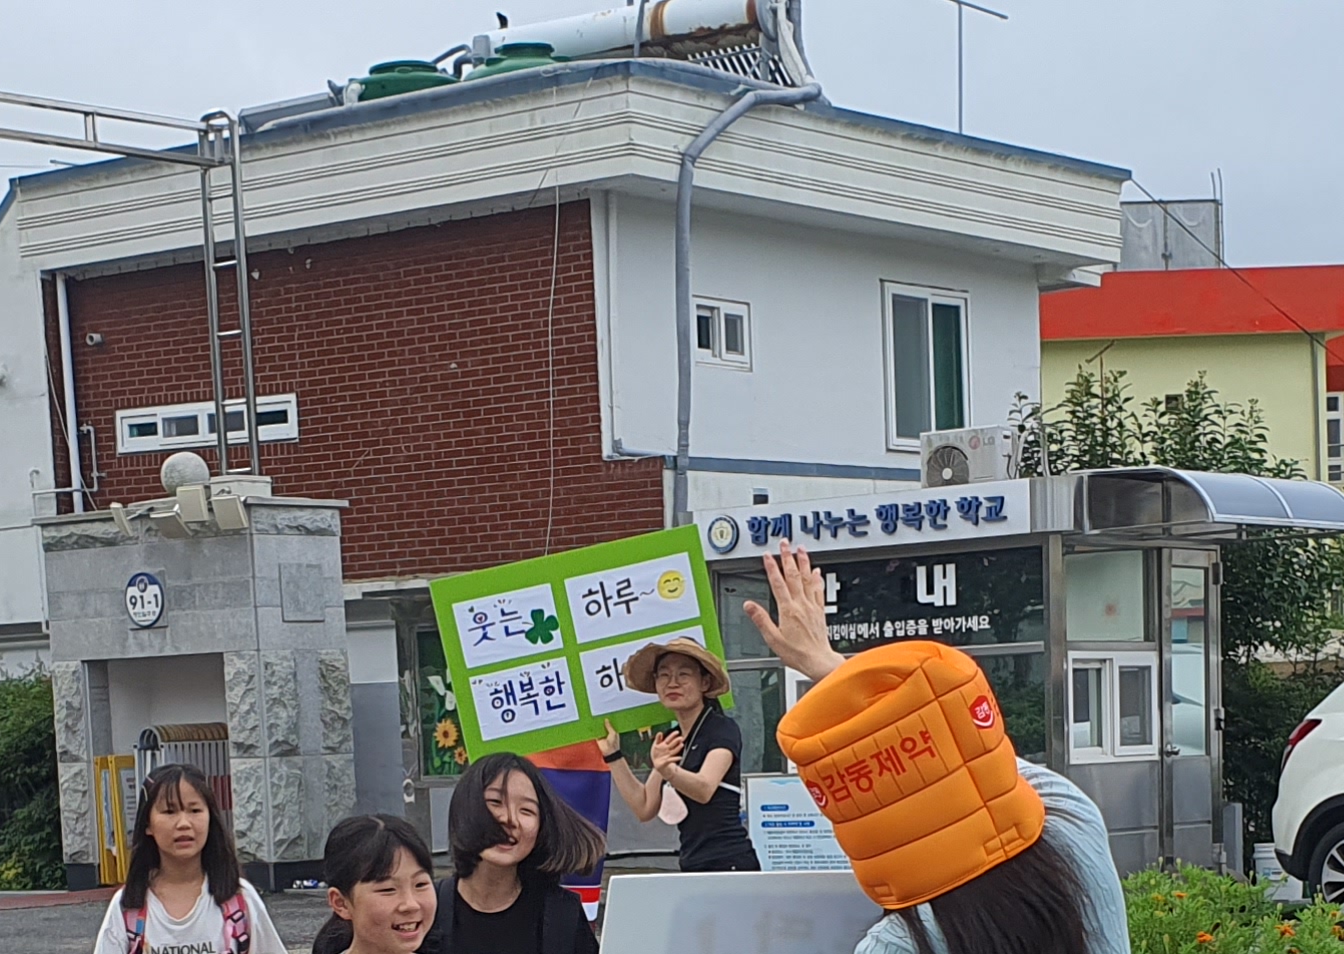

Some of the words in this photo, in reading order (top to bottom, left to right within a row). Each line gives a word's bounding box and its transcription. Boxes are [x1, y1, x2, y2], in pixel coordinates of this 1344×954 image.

[747, 513, 792, 545] 함께
[800, 509, 870, 540] 나누는
[875, 499, 951, 535] 행복한
[955, 496, 1007, 527] 학교
[129, 593, 159, 610] 91-1
[916, 563, 957, 607] 내
[468, 607, 527, 647] 웃는
[882, 619, 929, 638] 출입증을
[931, 614, 992, 634] 받아가세요
[489, 670, 567, 724] 행복한
[595, 657, 626, 692] 하
[821, 729, 937, 804] 감동제약
